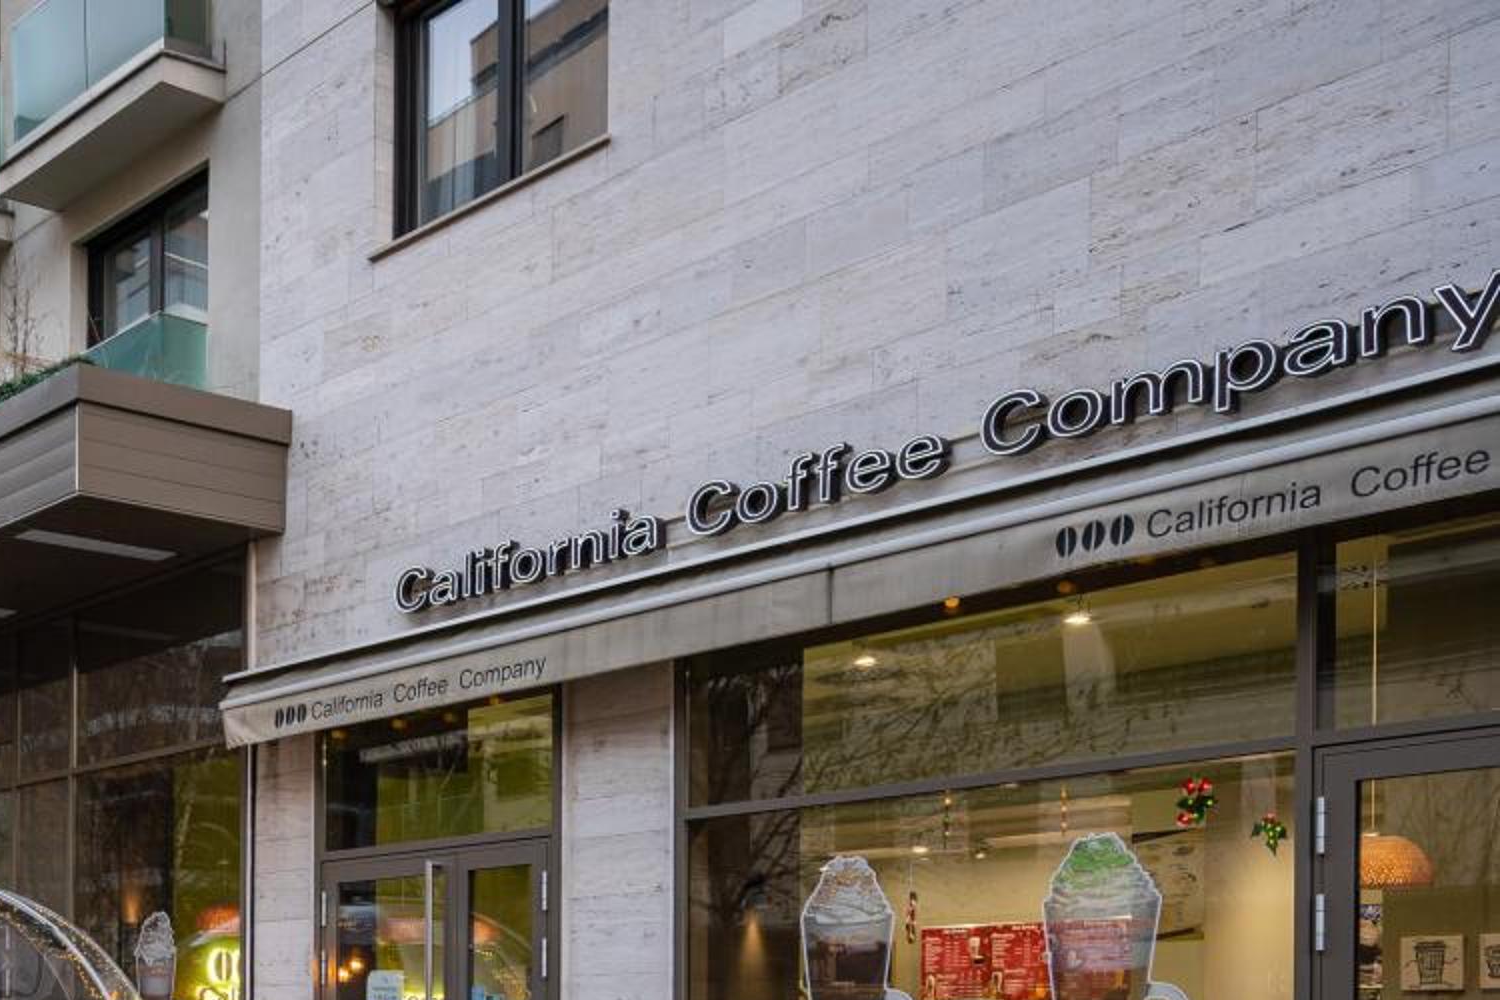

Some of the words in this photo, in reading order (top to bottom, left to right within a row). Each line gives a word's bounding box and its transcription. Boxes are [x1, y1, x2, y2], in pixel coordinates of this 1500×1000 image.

[394, 508, 665, 614] California
[684, 433, 949, 536] Coffee
[980, 269, 1500, 456] Company
[1146, 482, 1322, 539] California
[1350, 448, 1491, 498] Coffee
[310, 690, 384, 720] California
[392, 676, 449, 703] Coffee
[458, 656, 547, 690] Company
